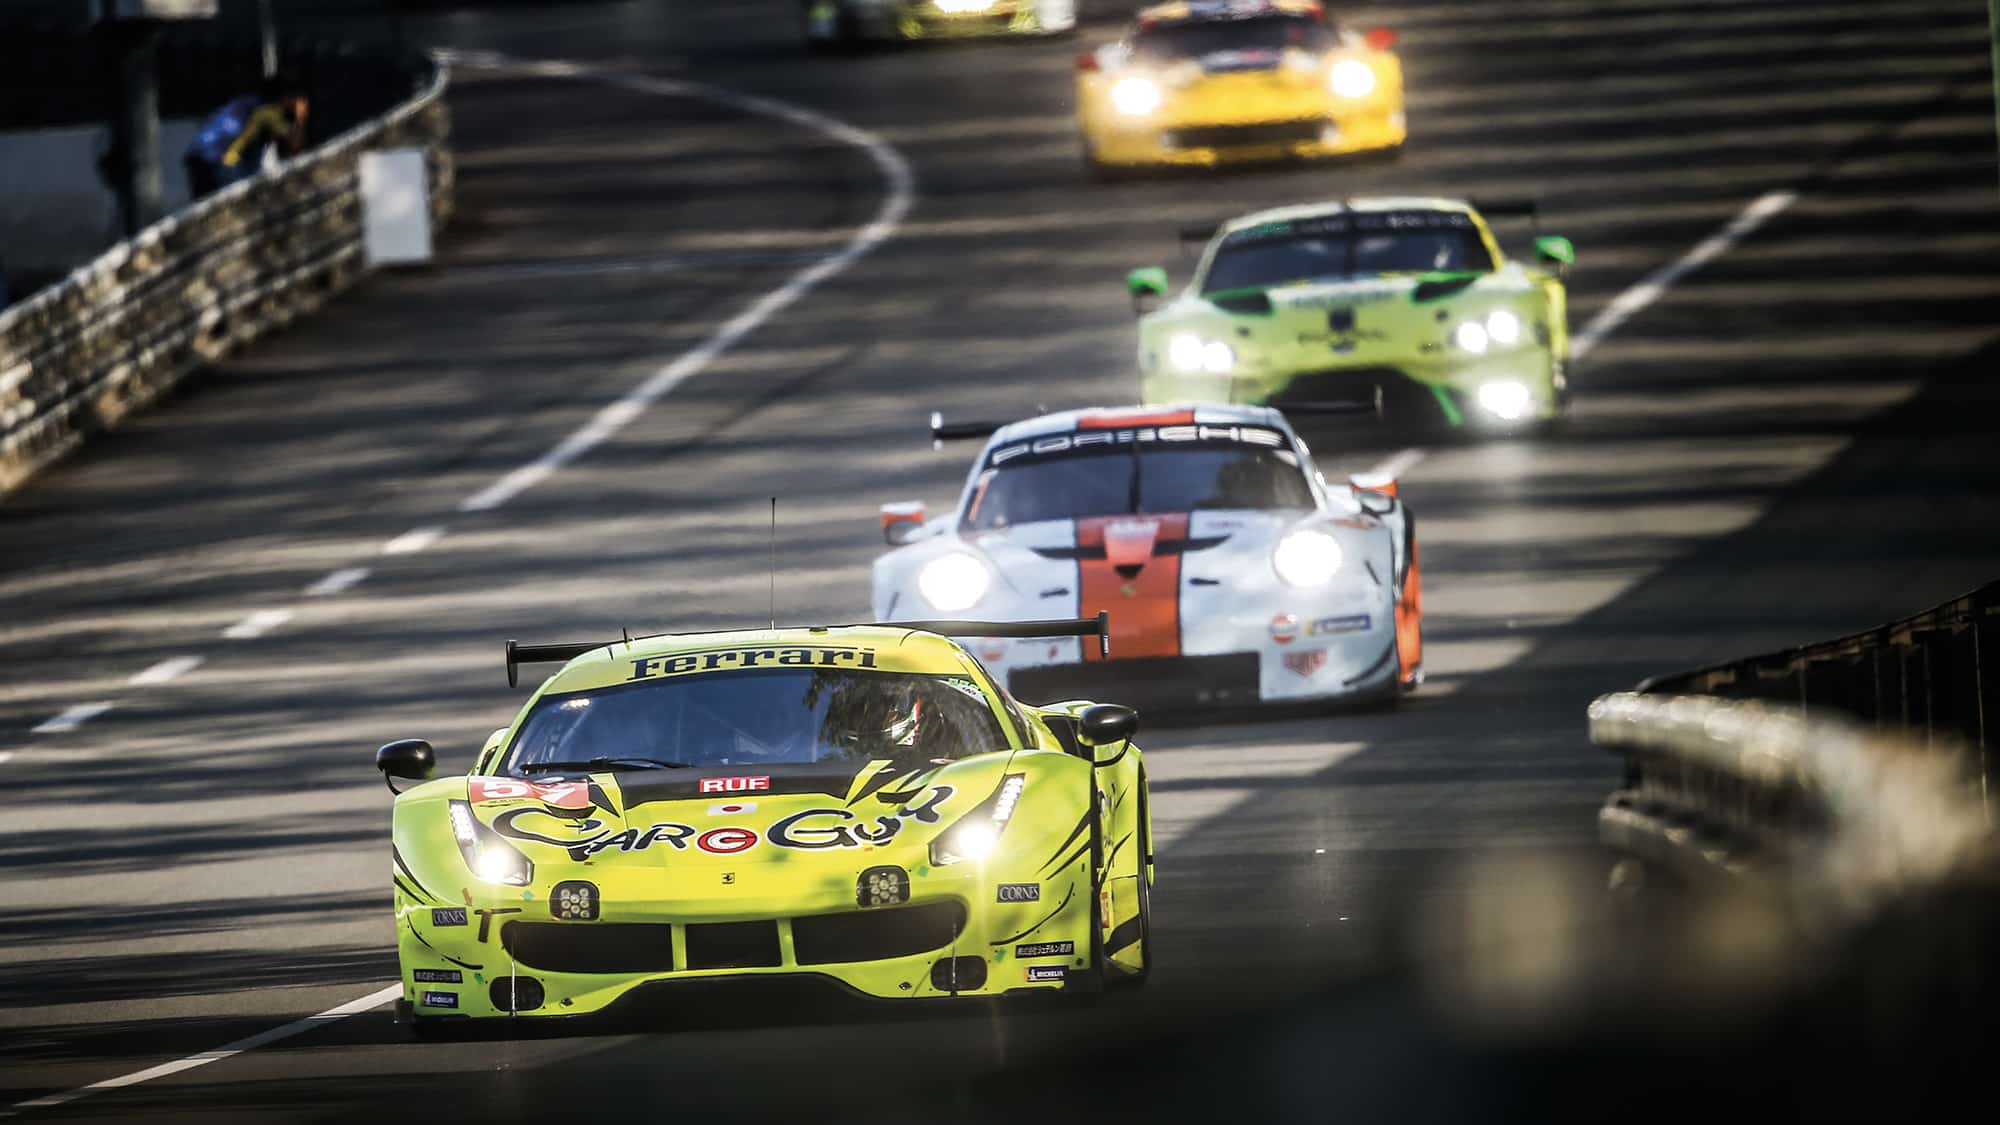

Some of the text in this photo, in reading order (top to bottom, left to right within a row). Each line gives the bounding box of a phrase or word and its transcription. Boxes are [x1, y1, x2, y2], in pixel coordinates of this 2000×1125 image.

[992, 426, 1284, 465] PORSCHE
[627, 646, 877, 681] Ferrari
[703, 778, 767, 793] RUF
[1000, 886, 1040, 901] CORNES
